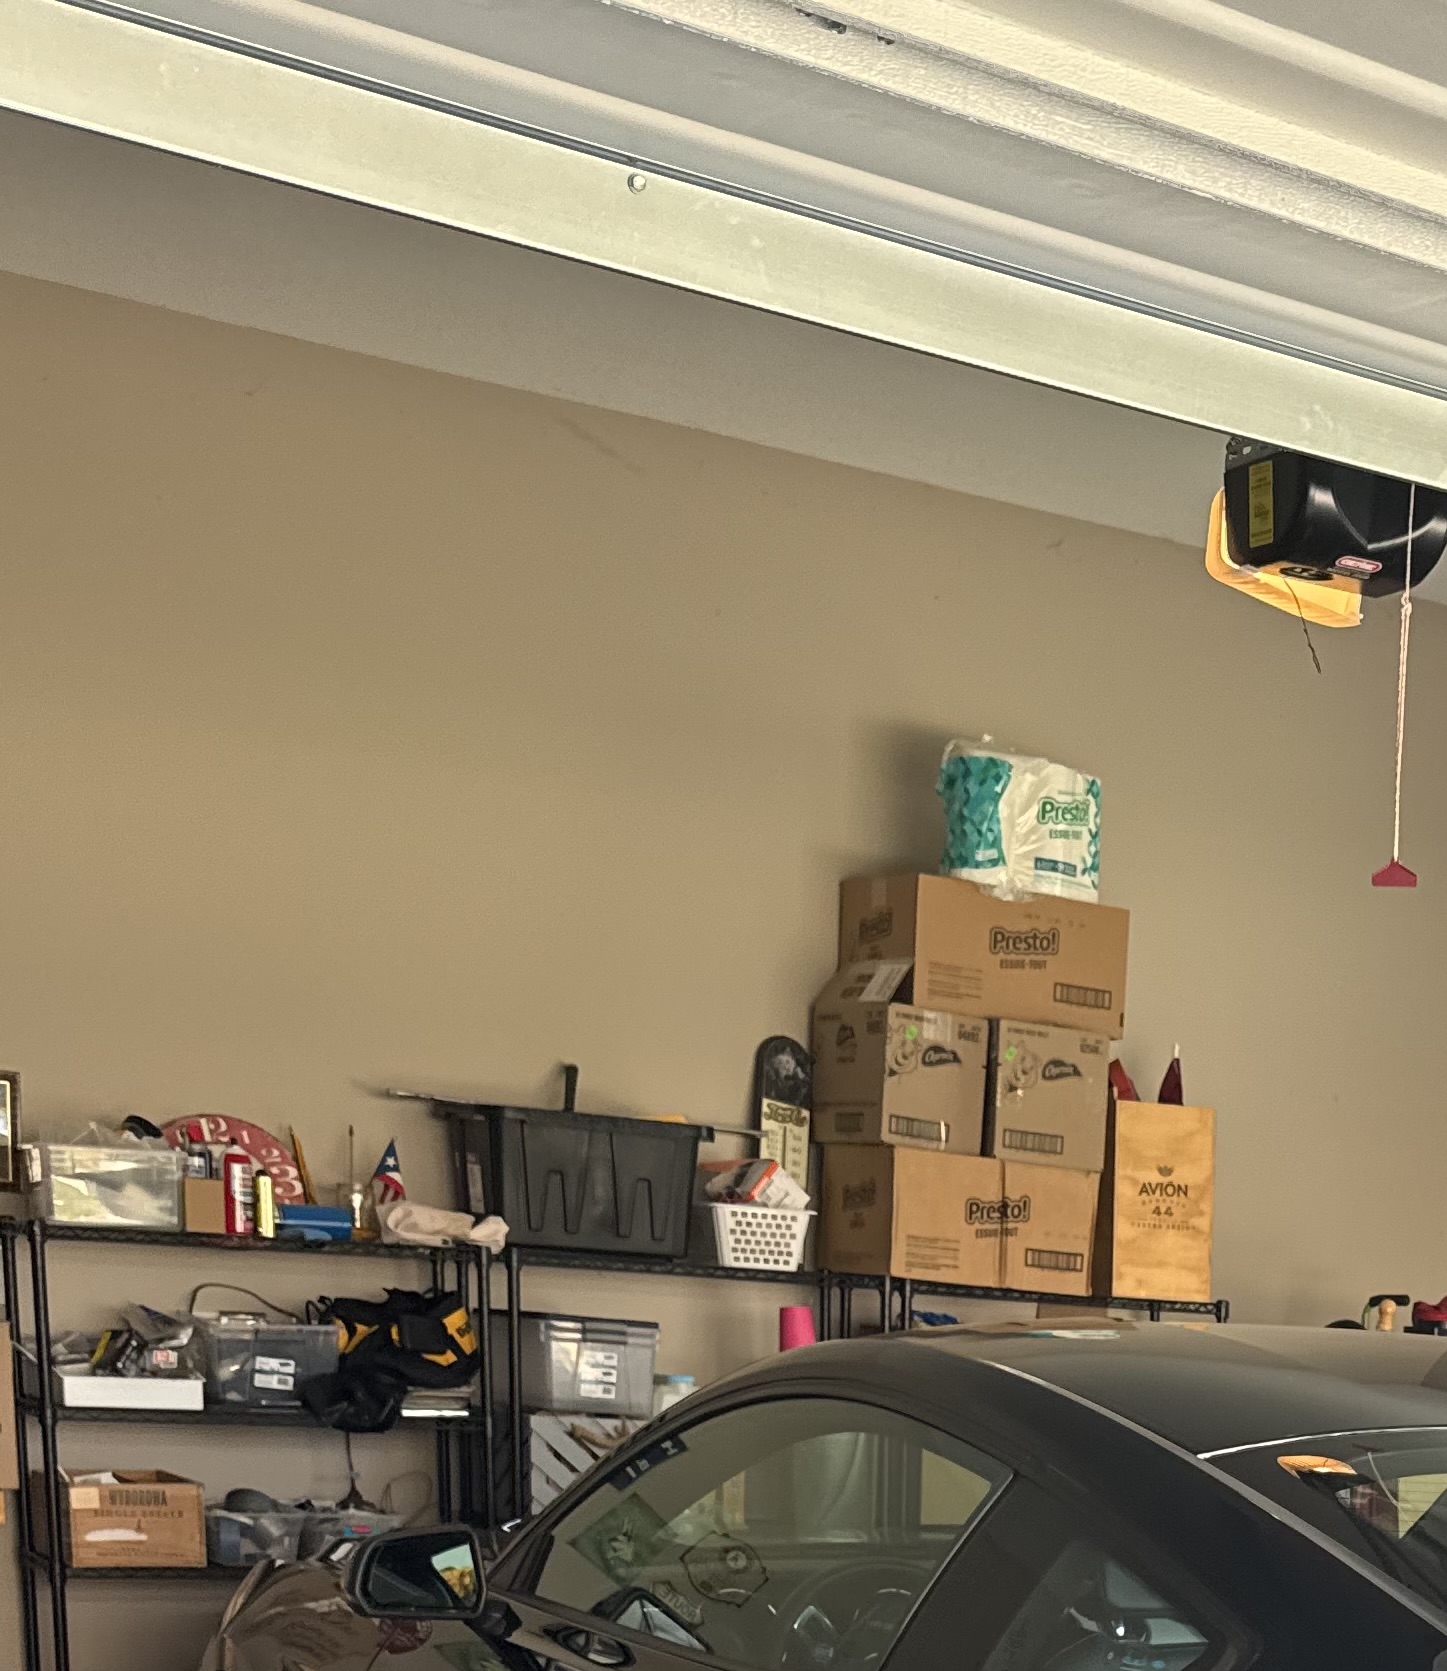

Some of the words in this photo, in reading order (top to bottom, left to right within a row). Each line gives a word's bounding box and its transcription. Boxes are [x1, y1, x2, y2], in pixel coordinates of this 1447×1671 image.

[1040, 799, 1089, 824] Presto!
[992, 929, 1057, 952] Presto!
[967, 1197, 1029, 1221] Presto!
